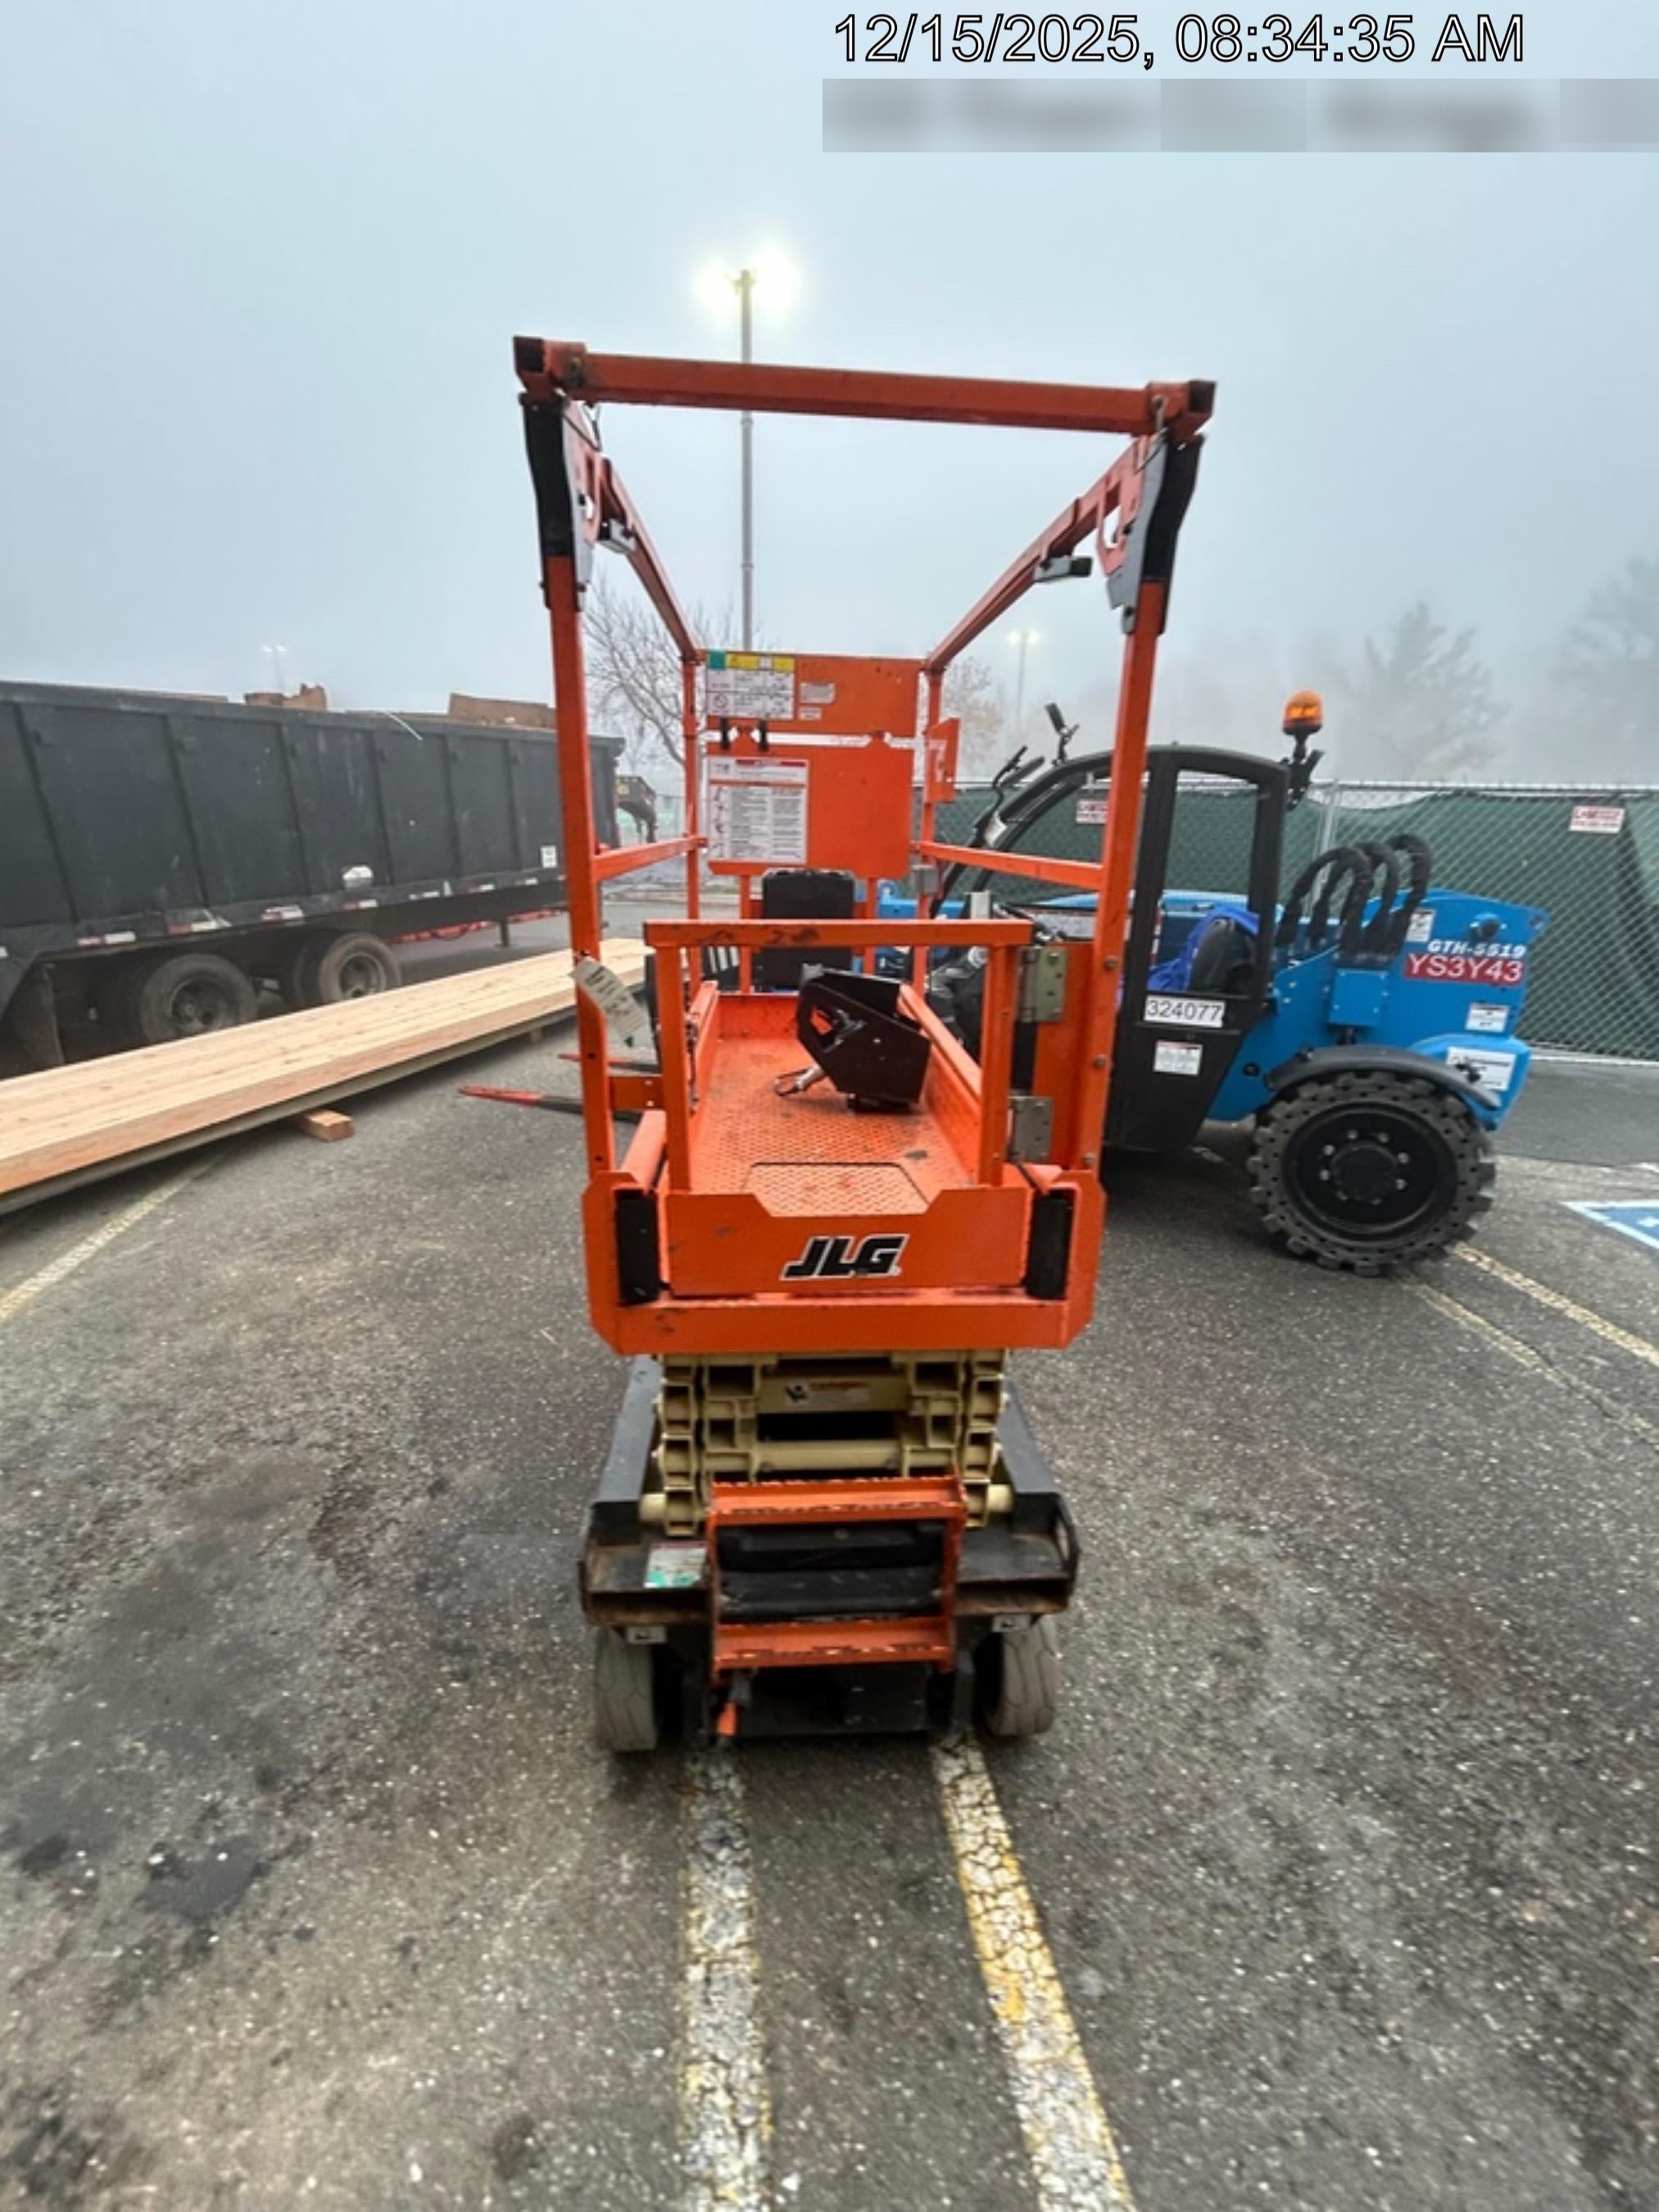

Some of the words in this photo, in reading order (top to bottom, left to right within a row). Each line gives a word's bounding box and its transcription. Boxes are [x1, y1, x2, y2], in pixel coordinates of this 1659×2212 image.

[1427, 940, 1527, 959] GTH-5519
[1408, 953, 1523, 982] YS3Y43
[1148, 999, 1222, 1022] 324077
[781, 1234, 909, 1280] JLG
